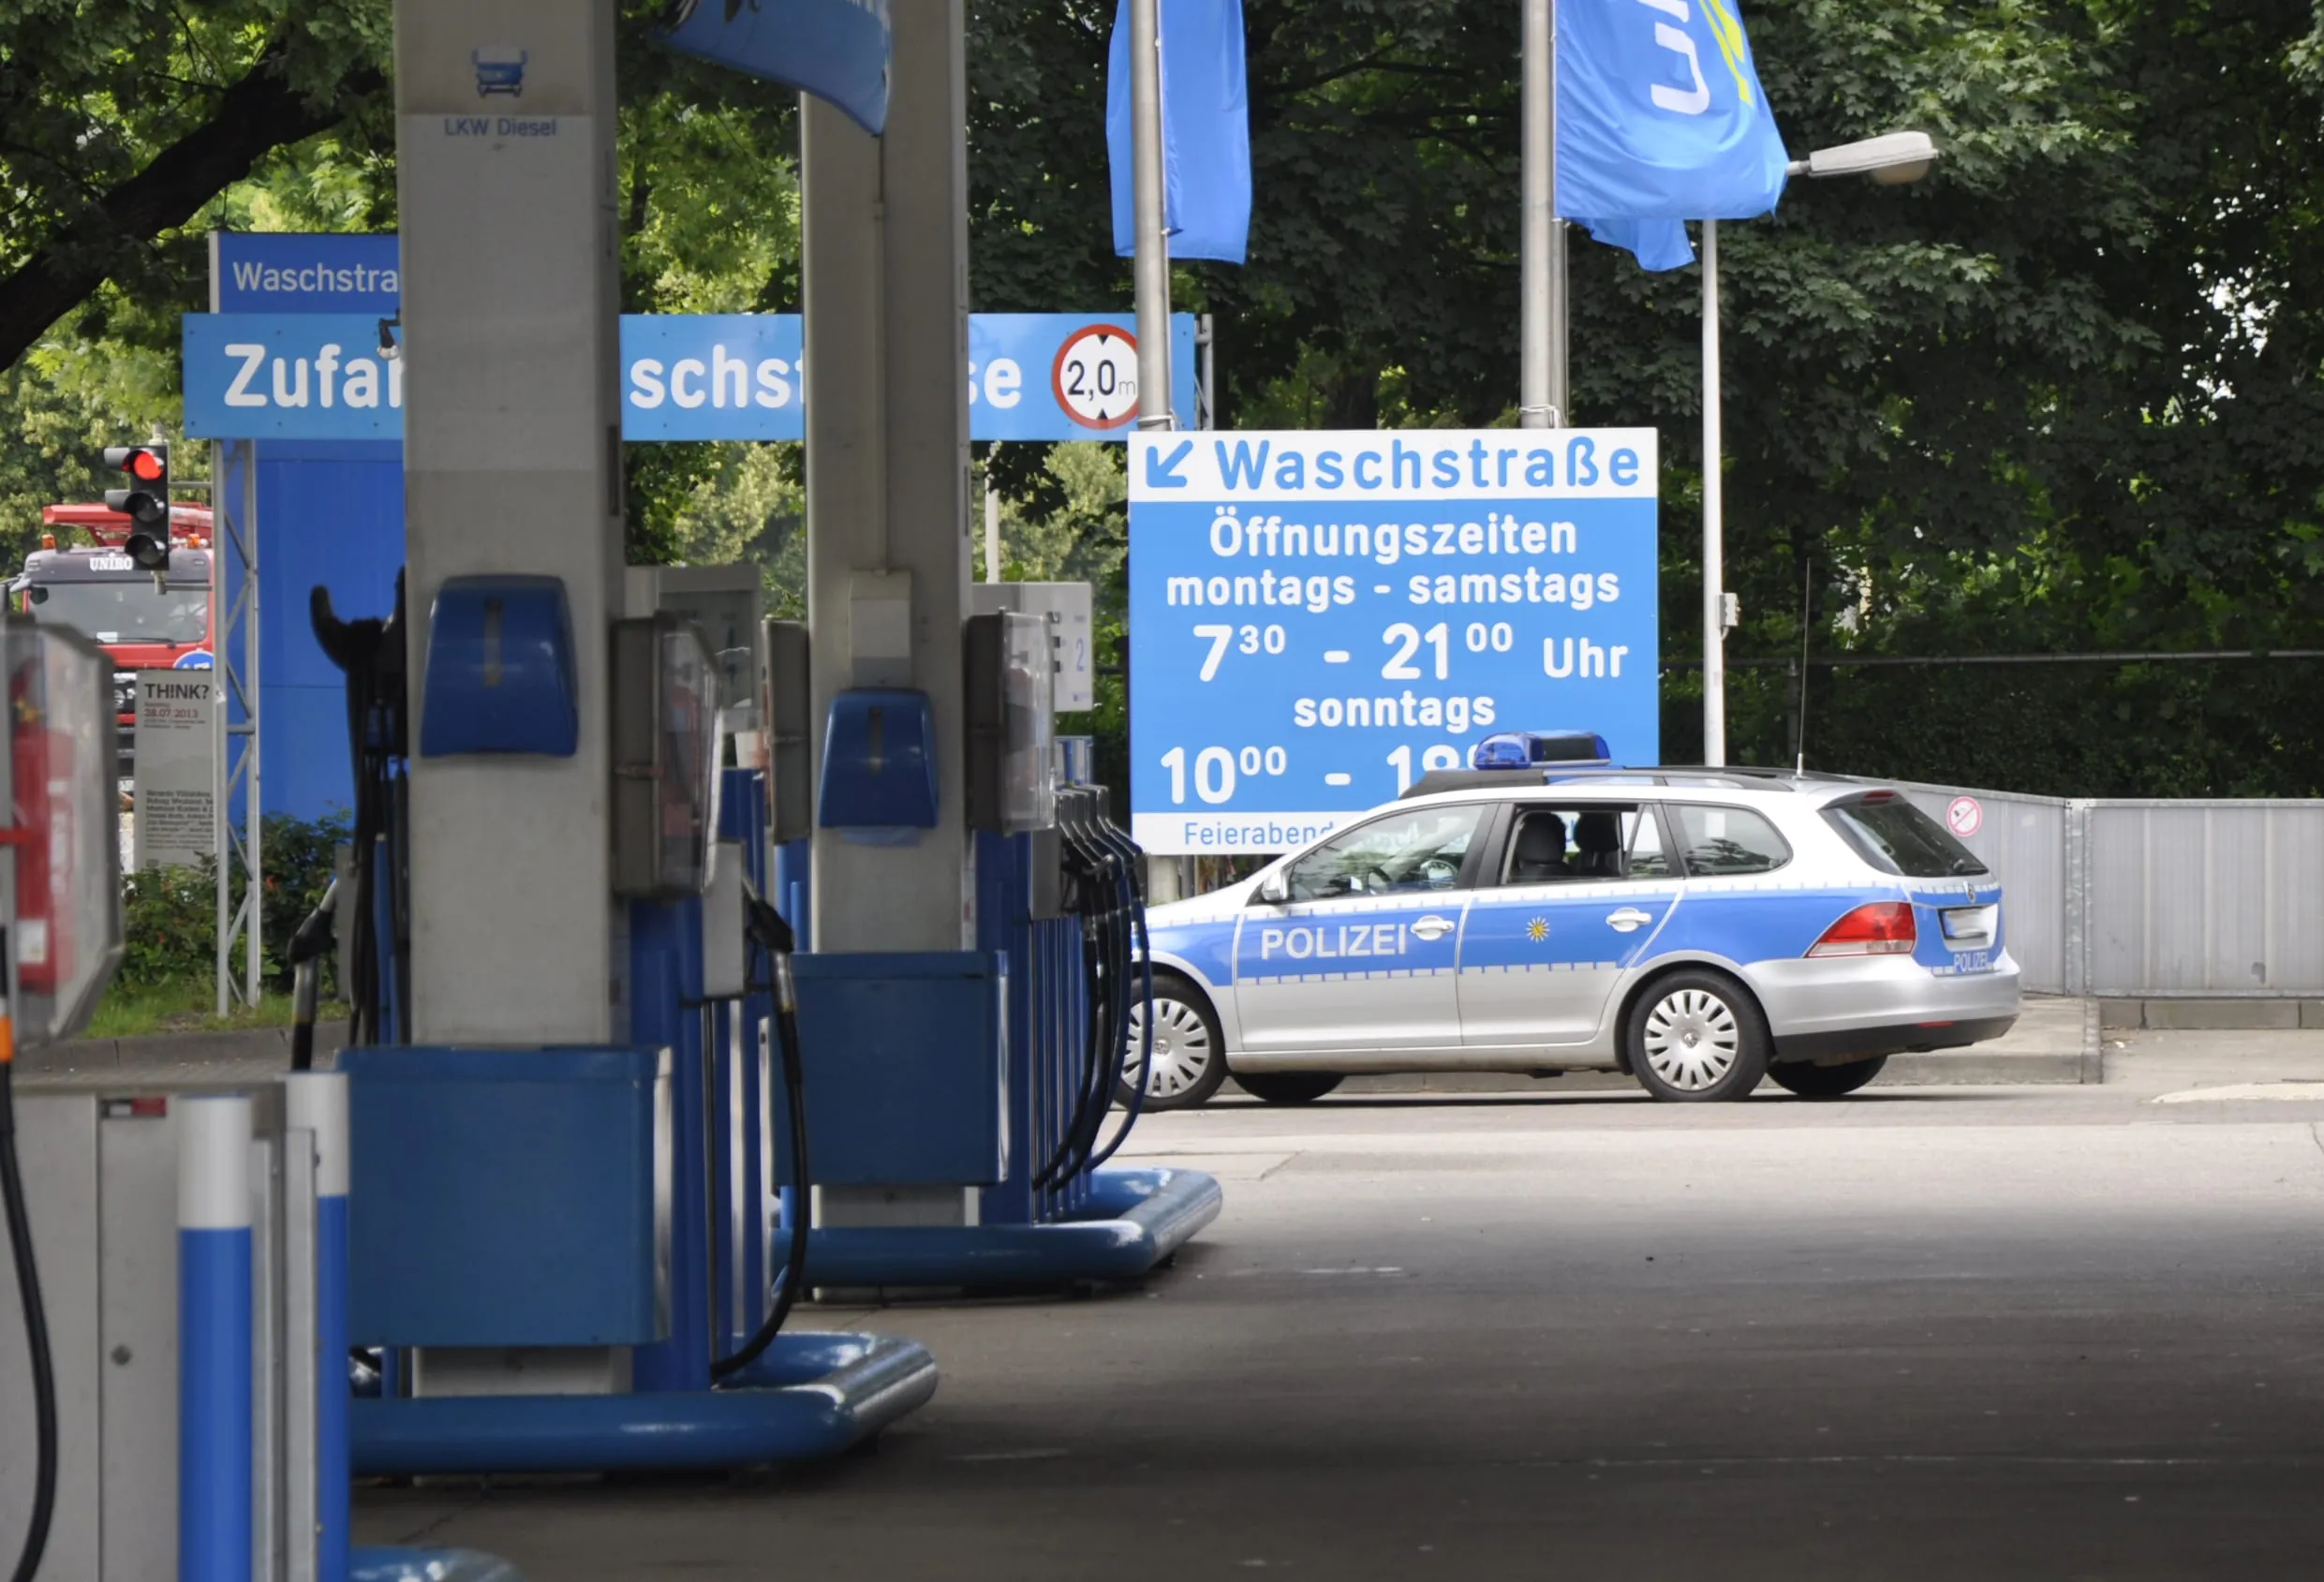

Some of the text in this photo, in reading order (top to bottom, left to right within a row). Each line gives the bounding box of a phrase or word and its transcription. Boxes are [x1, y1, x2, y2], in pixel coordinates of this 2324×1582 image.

[444, 118, 556, 137] LKW Diesel
[1215, 436, 1639, 490] Waschstraße
[1210, 506, 1576, 565] Öffnungszeiten
[1167, 569, 1355, 613] montags
[1408, 567, 1620, 611] samstags
[1075, 637, 1085, 672] 2
[1543, 638, 1629, 678] Uhr
[1294, 690, 1496, 733] sonntags
[1261, 924, 1407, 960] POLIZEI
